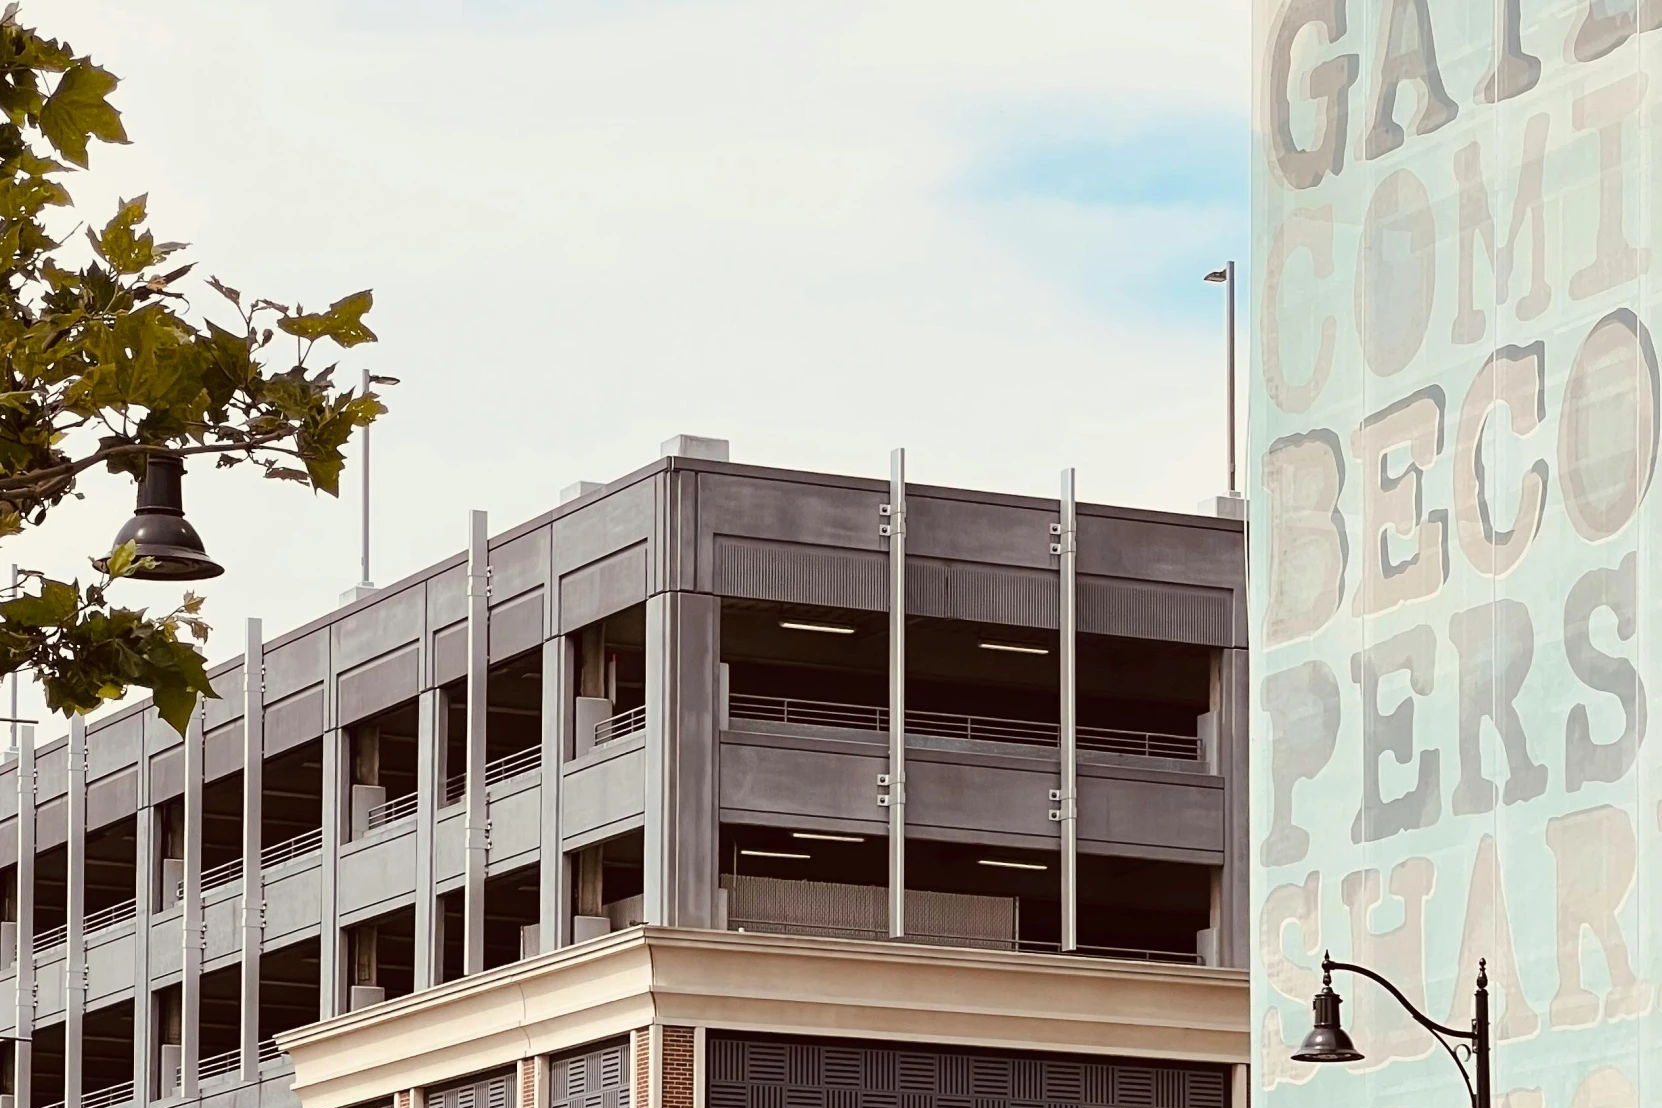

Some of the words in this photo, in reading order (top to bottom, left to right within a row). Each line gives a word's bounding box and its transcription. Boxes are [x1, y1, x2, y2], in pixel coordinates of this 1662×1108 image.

[1260, 0, 1662, 191] GA
[1260, 551, 1648, 868] PERS
[1260, 805, 1660, 1091] SHAR
